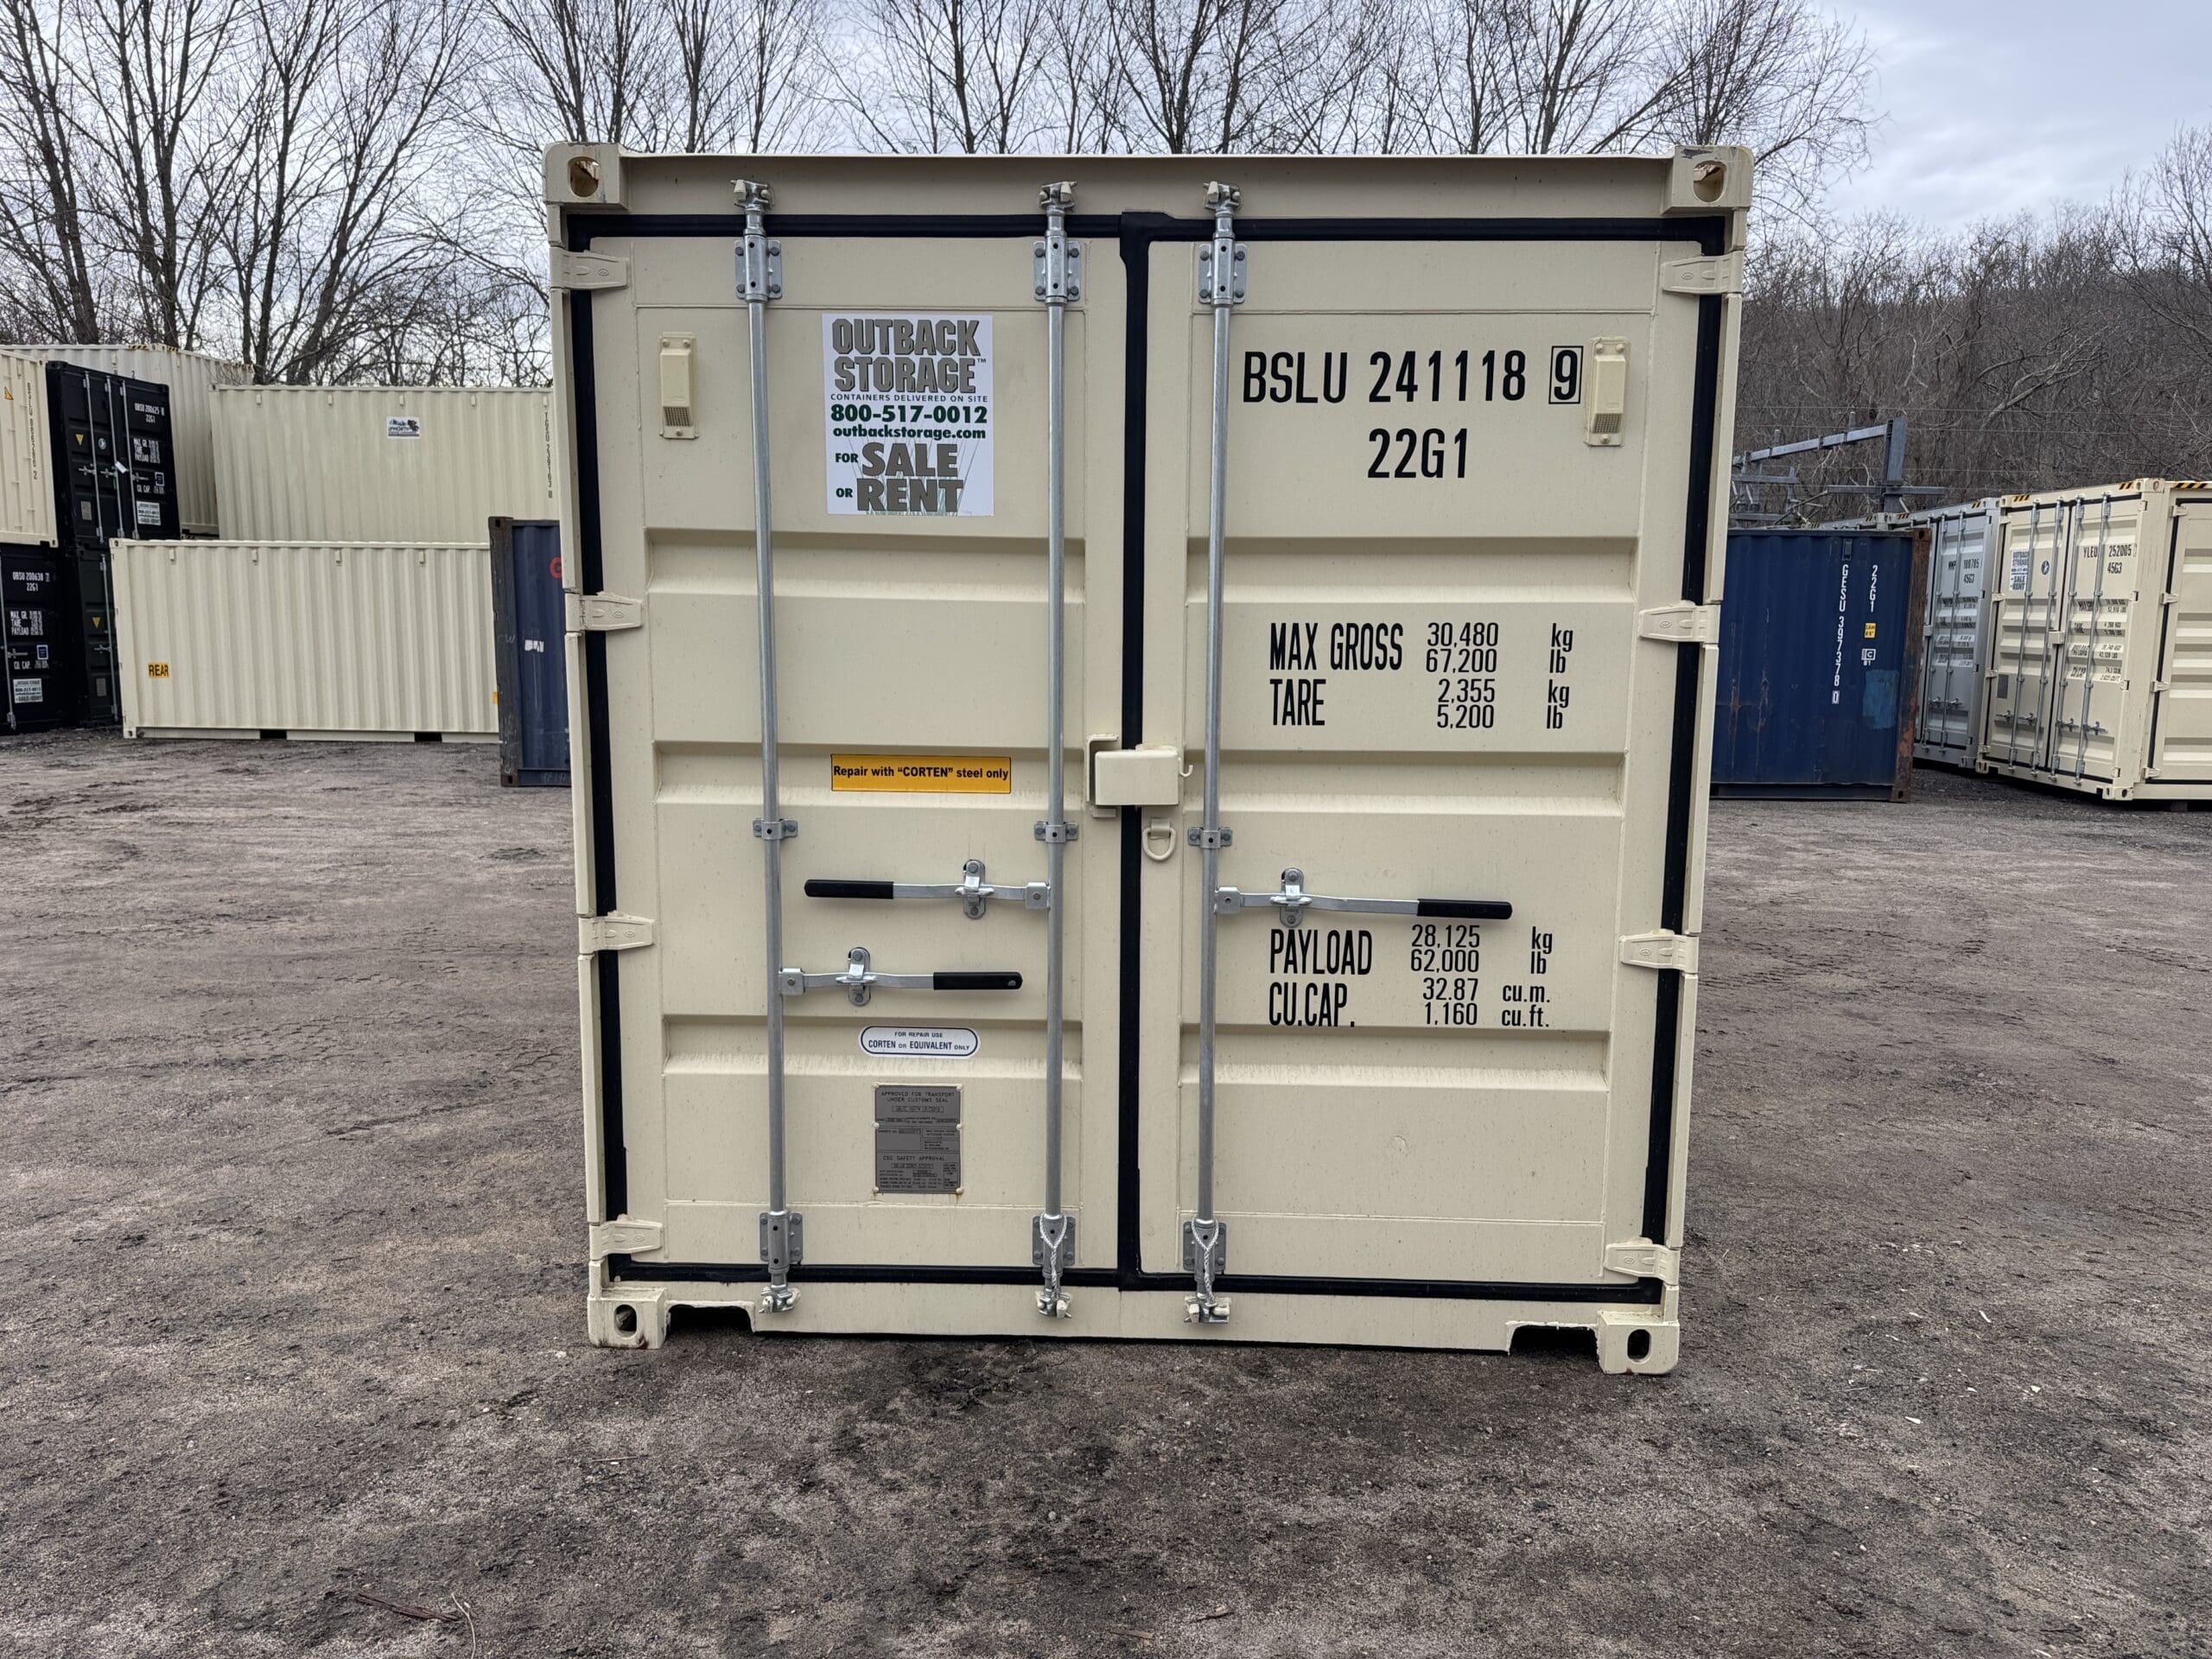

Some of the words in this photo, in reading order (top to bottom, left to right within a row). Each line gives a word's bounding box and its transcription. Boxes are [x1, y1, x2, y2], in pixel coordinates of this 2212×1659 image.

[832, 318, 981, 356] OUTBACK
[834, 356, 976, 393] STORAGE
[1243, 351, 1348, 404] BSLU
[1369, 349, 1526, 403] 241118
[1554, 348, 1578, 400] 9
[830, 393, 891, 402] CONTAINERS
[893, 394, 946, 403] DELIVERED
[830, 404, 988, 423] 800-517-0012
[833, 424, 986, 441] outbackstorage.com
[836, 453, 859, 463] FOR
[861, 442, 958, 478] SALE
[1367, 428, 1468, 479] 22G1
[836, 487, 853, 498] OR
[856, 478, 963, 512] RENT
[2108, 544, 2132, 557] 252005
[2107, 562, 2123, 574] 45G3
[1840, 564, 1849, 612] GESU
[1869, 565, 1878, 613] 22G1
[1269, 622, 1319, 671] MAX
[1330, 622, 1403, 671] GROSS
[1427, 622, 1499, 648] 30,480
[1551, 623, 1573, 652] kg
[1834, 616, 1845, 686] 397378
[149, 664, 168, 677] REAR
[1426, 649, 1497, 673] 67,200
[1549, 650, 1567, 674] lb
[1269, 678, 1326, 726] TARE
[1438, 678, 1496, 703] 2,355
[1548, 679, 1570, 708] kg
[1437, 705, 1495, 729] 5,200
[1546, 706, 1563, 729] lb
[834, 766, 868, 779] Repair
[871, 766, 894, 777] with
[957, 768, 982, 778] steel
[986, 769, 1008, 780] only
[1269, 928, 1373, 976] PAYLOAD
[1411, 924, 1480, 949] 28,125
[1531, 926, 1553, 954] kg
[1411, 950, 1479, 973] 62,000
[1530, 951, 1547, 975] lb
[1422, 978, 1479, 1001] 32.87
[1503, 984, 1551, 1002] cu.m.
[1425, 1002, 1478, 1026] 1,160
[1501, 1005, 1549, 1027] cu.ft.
[868, 1039, 896, 1049] CORTEN
[909, 1041, 952, 1050] EQUIVALENT
